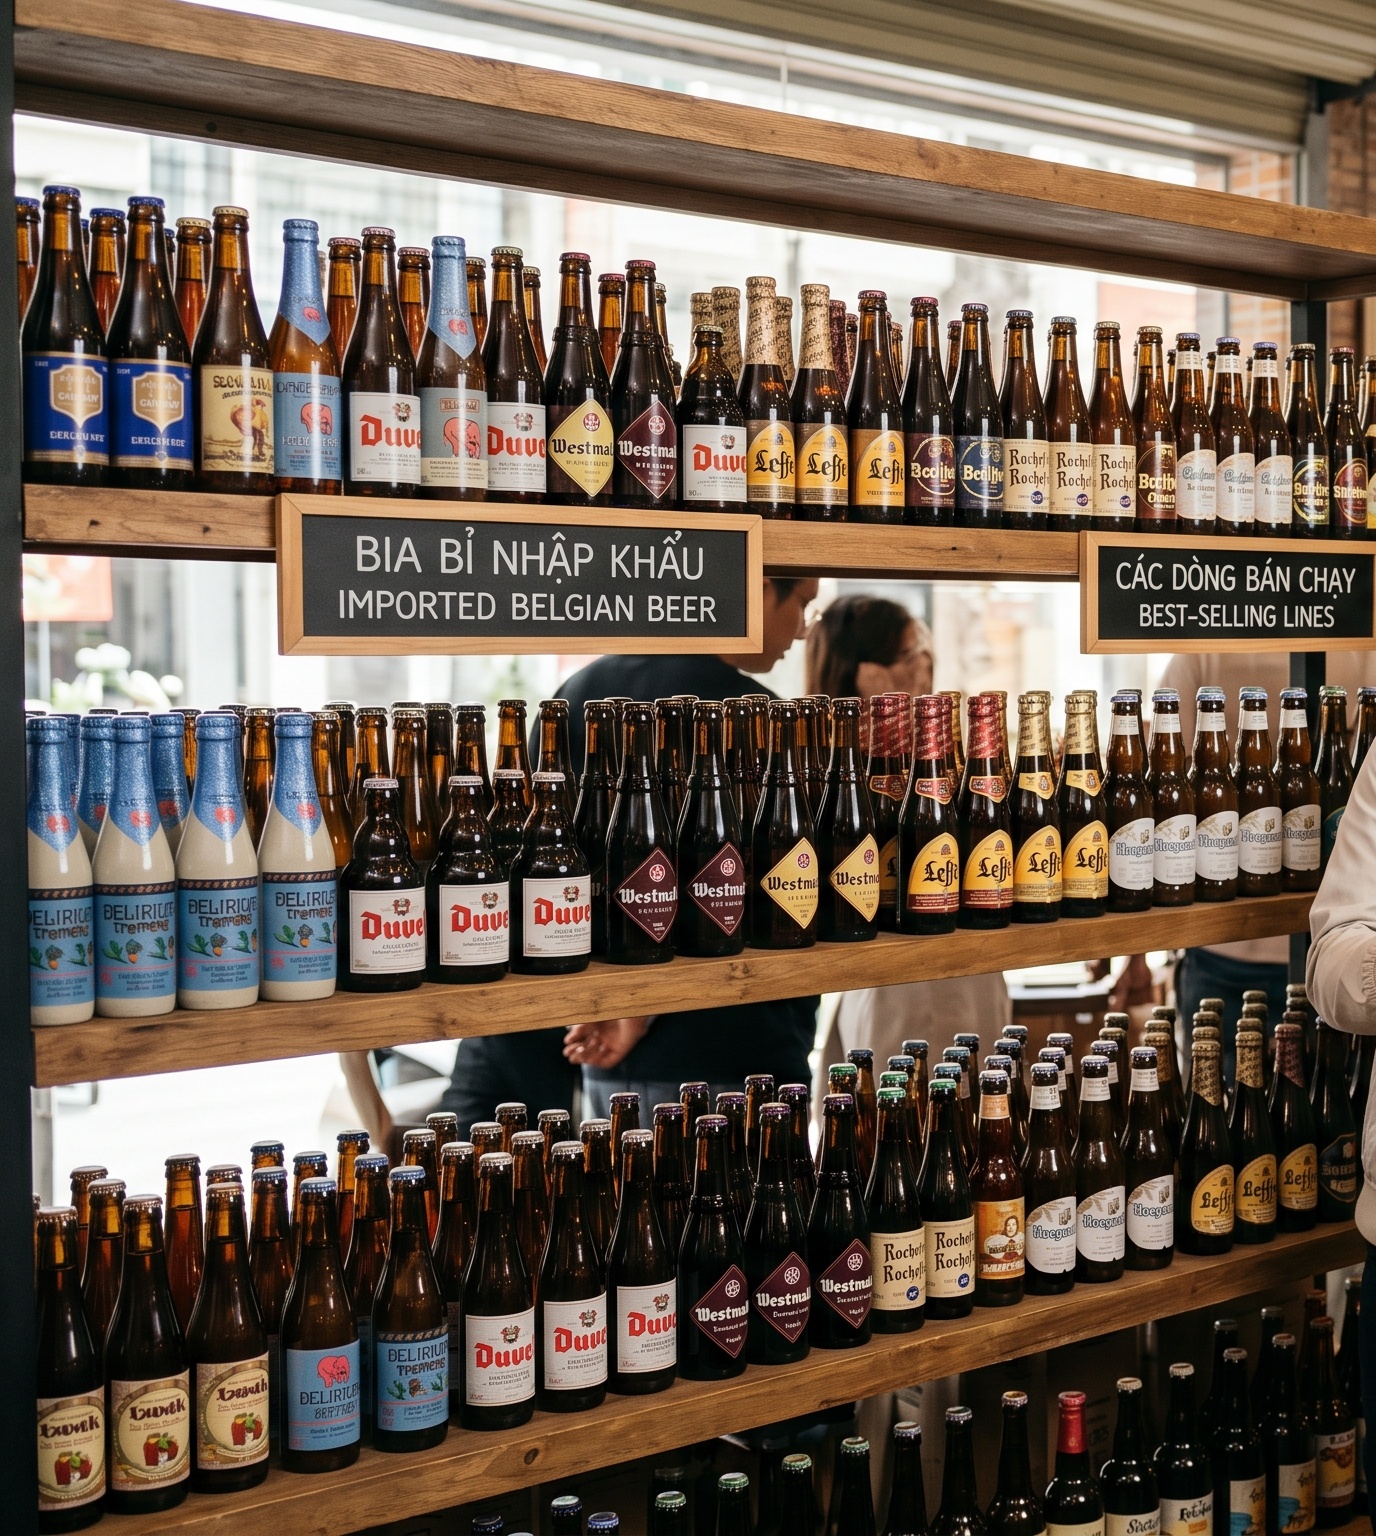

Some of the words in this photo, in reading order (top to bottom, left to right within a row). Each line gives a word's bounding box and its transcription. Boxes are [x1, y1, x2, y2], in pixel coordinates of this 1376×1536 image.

[356, 535, 422, 573] BIA
[440, 526, 475, 575] BỈ
[493, 531, 595, 584] NHẬP
[611, 529, 705, 580] KHẨU
[1115, 553, 1163, 590] CÁC
[1172, 554, 1236, 592] DÒNG
[1246, 556, 1291, 593] BÁN
[1299, 565, 1357, 600] CHẠY
[338, 589, 496, 621] IMPORTED
[511, 592, 634, 623] BELGIAN
[648, 594, 717, 623] BEER
[1139, 603, 1277, 628] BEST-SELLING
[1284, 605, 1335, 628] LINES
